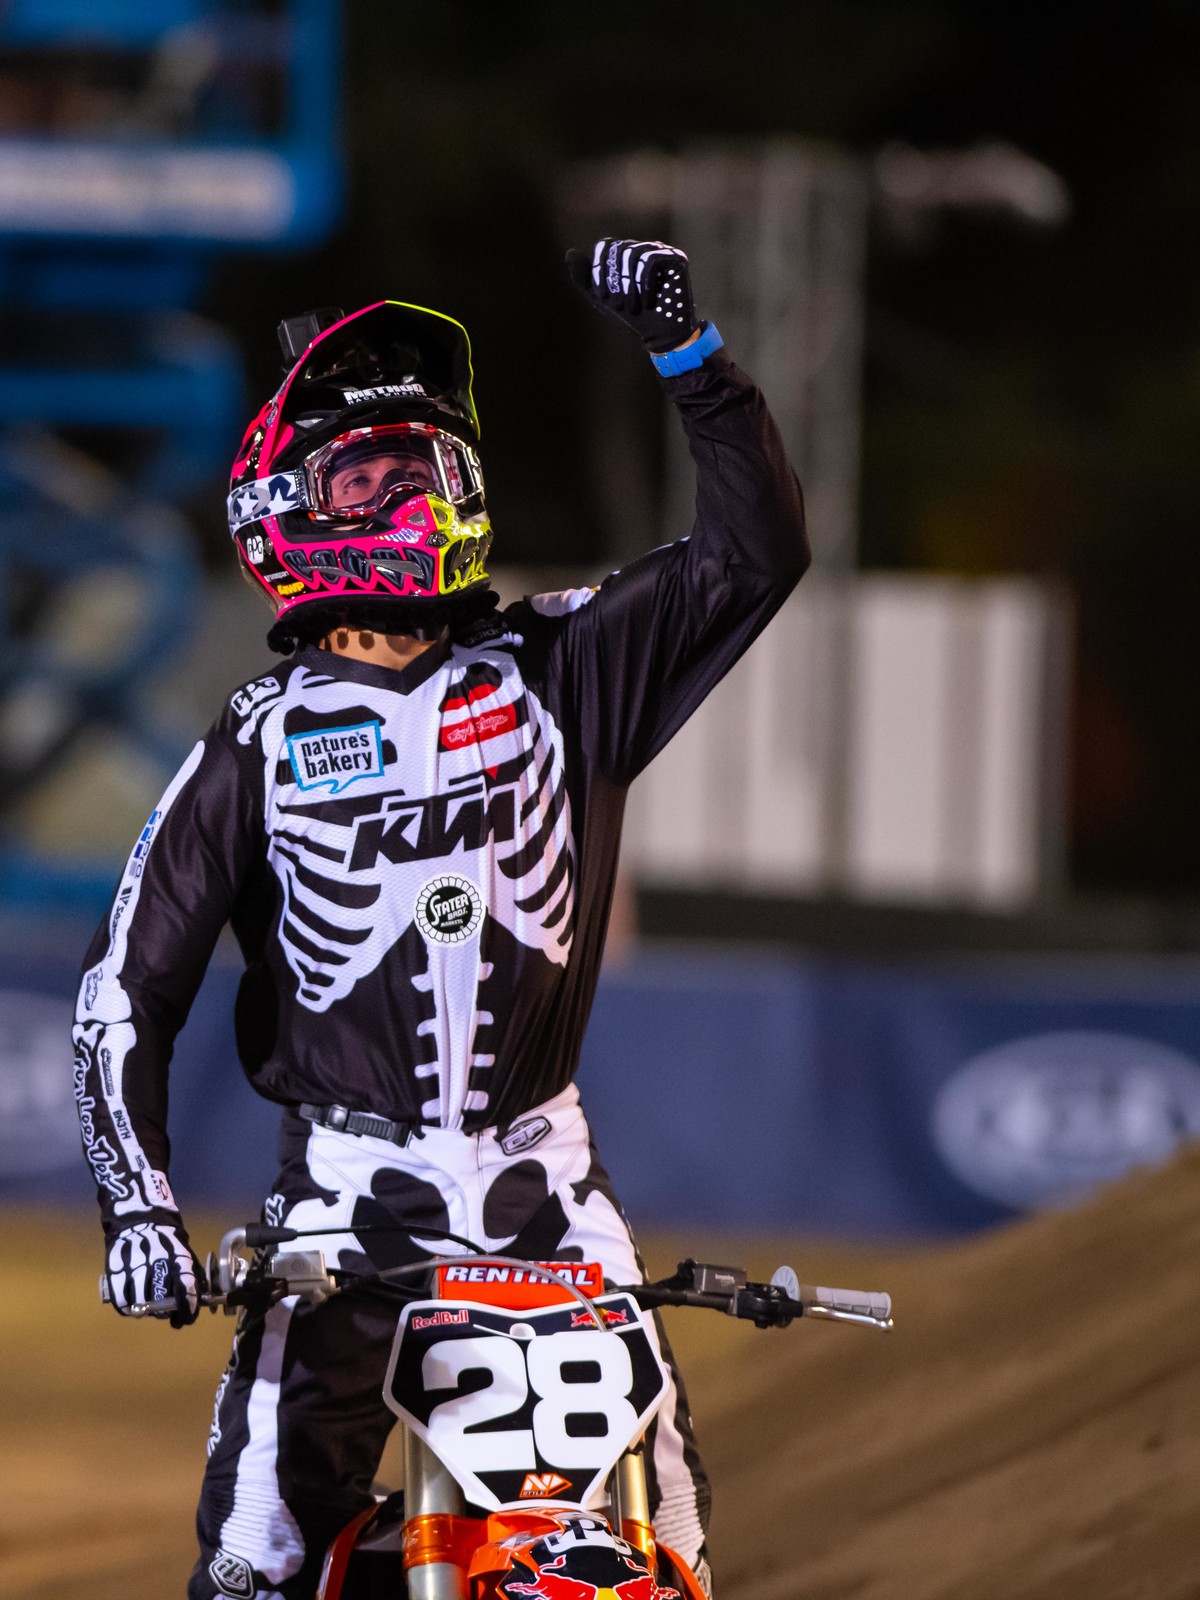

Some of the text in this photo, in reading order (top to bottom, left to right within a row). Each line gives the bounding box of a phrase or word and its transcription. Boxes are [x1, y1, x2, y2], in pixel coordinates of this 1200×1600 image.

[343, 383, 425, 402] METHOD
[233, 678, 276, 711] PPG
[301, 731, 370, 758] nature's
[304, 751, 372, 779] bakery
[348, 788, 515, 872] KTM
[430, 894, 469, 926] STATER
[113, 1109, 131, 1140] BN3TH
[412, 1309, 469, 1330] Red Bull
[422, 1331, 639, 1472] 28
